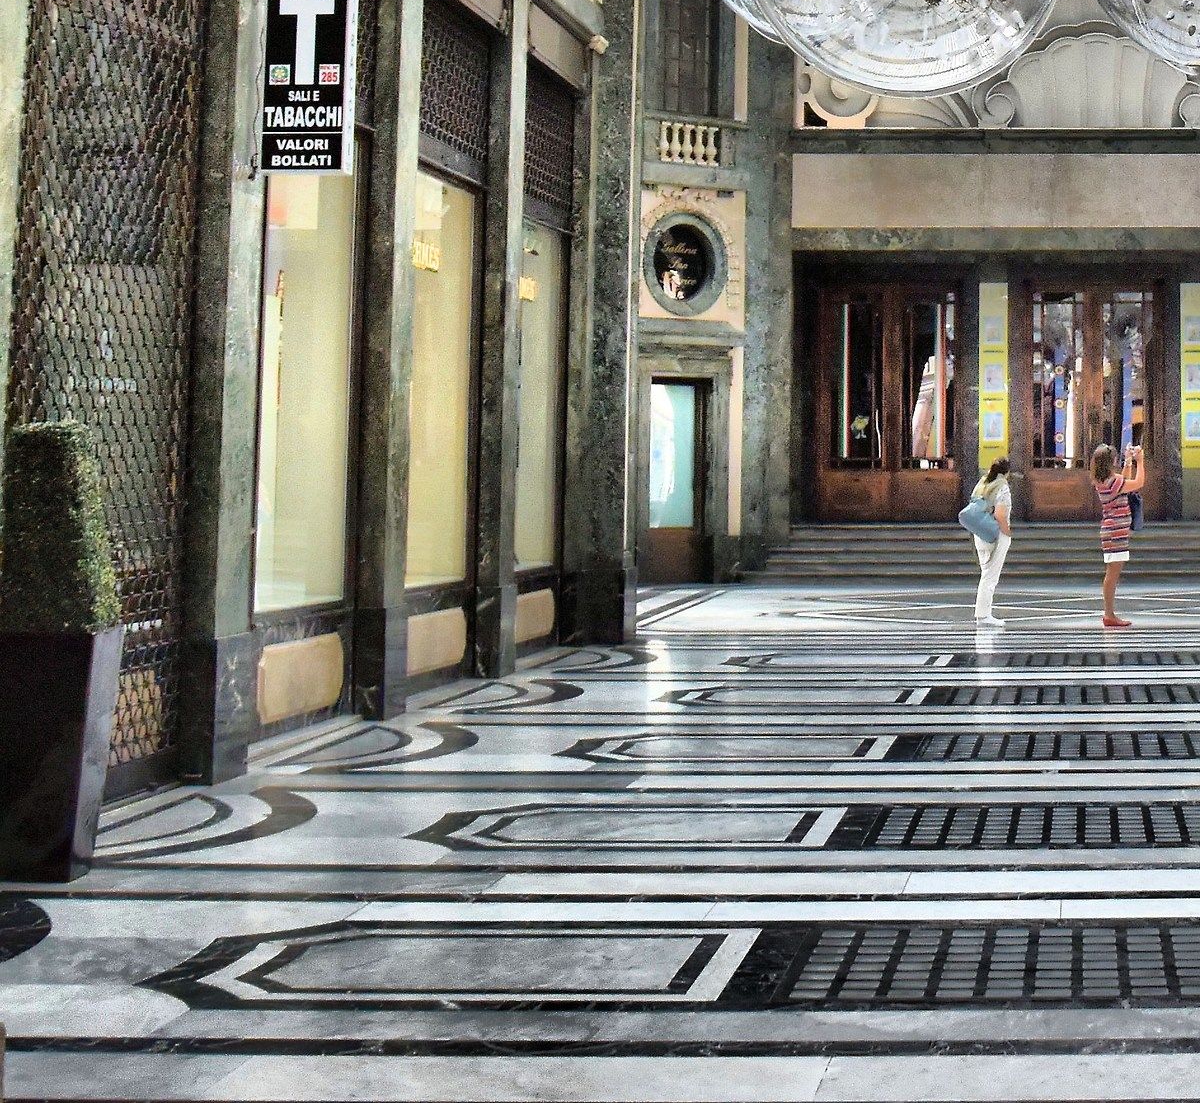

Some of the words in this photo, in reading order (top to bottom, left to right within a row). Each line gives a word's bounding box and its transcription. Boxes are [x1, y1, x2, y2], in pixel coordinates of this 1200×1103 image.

[321, 71, 338, 83] 285
[288, 90, 311, 102] SALI
[313, 90, 320, 102] E
[264, 105, 342, 128] TABACCHI
[276, 138, 329, 151] VALORI
[271, 154, 332, 167] BOLLATI
